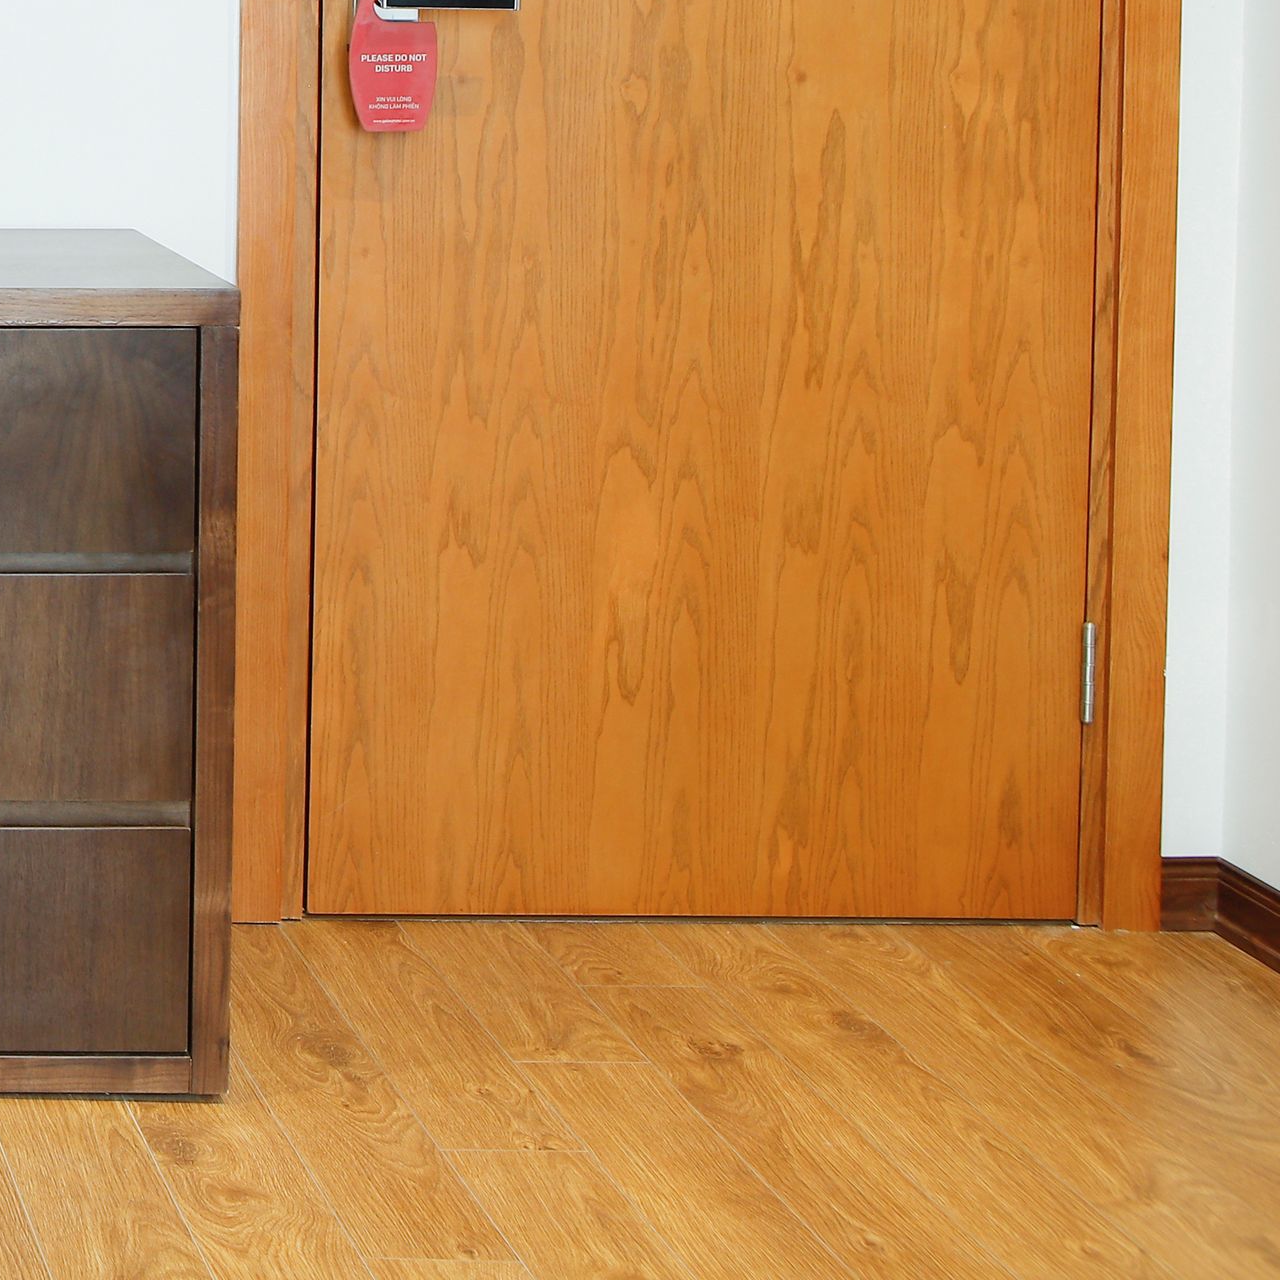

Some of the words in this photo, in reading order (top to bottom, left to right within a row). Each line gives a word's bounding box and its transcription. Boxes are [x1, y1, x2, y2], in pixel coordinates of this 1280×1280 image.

[361, 54, 394, 62] PLEASE
[394, 54, 408, 62] DO
[409, 54, 427, 62] NOT
[375, 64, 413, 73] DISTURB
